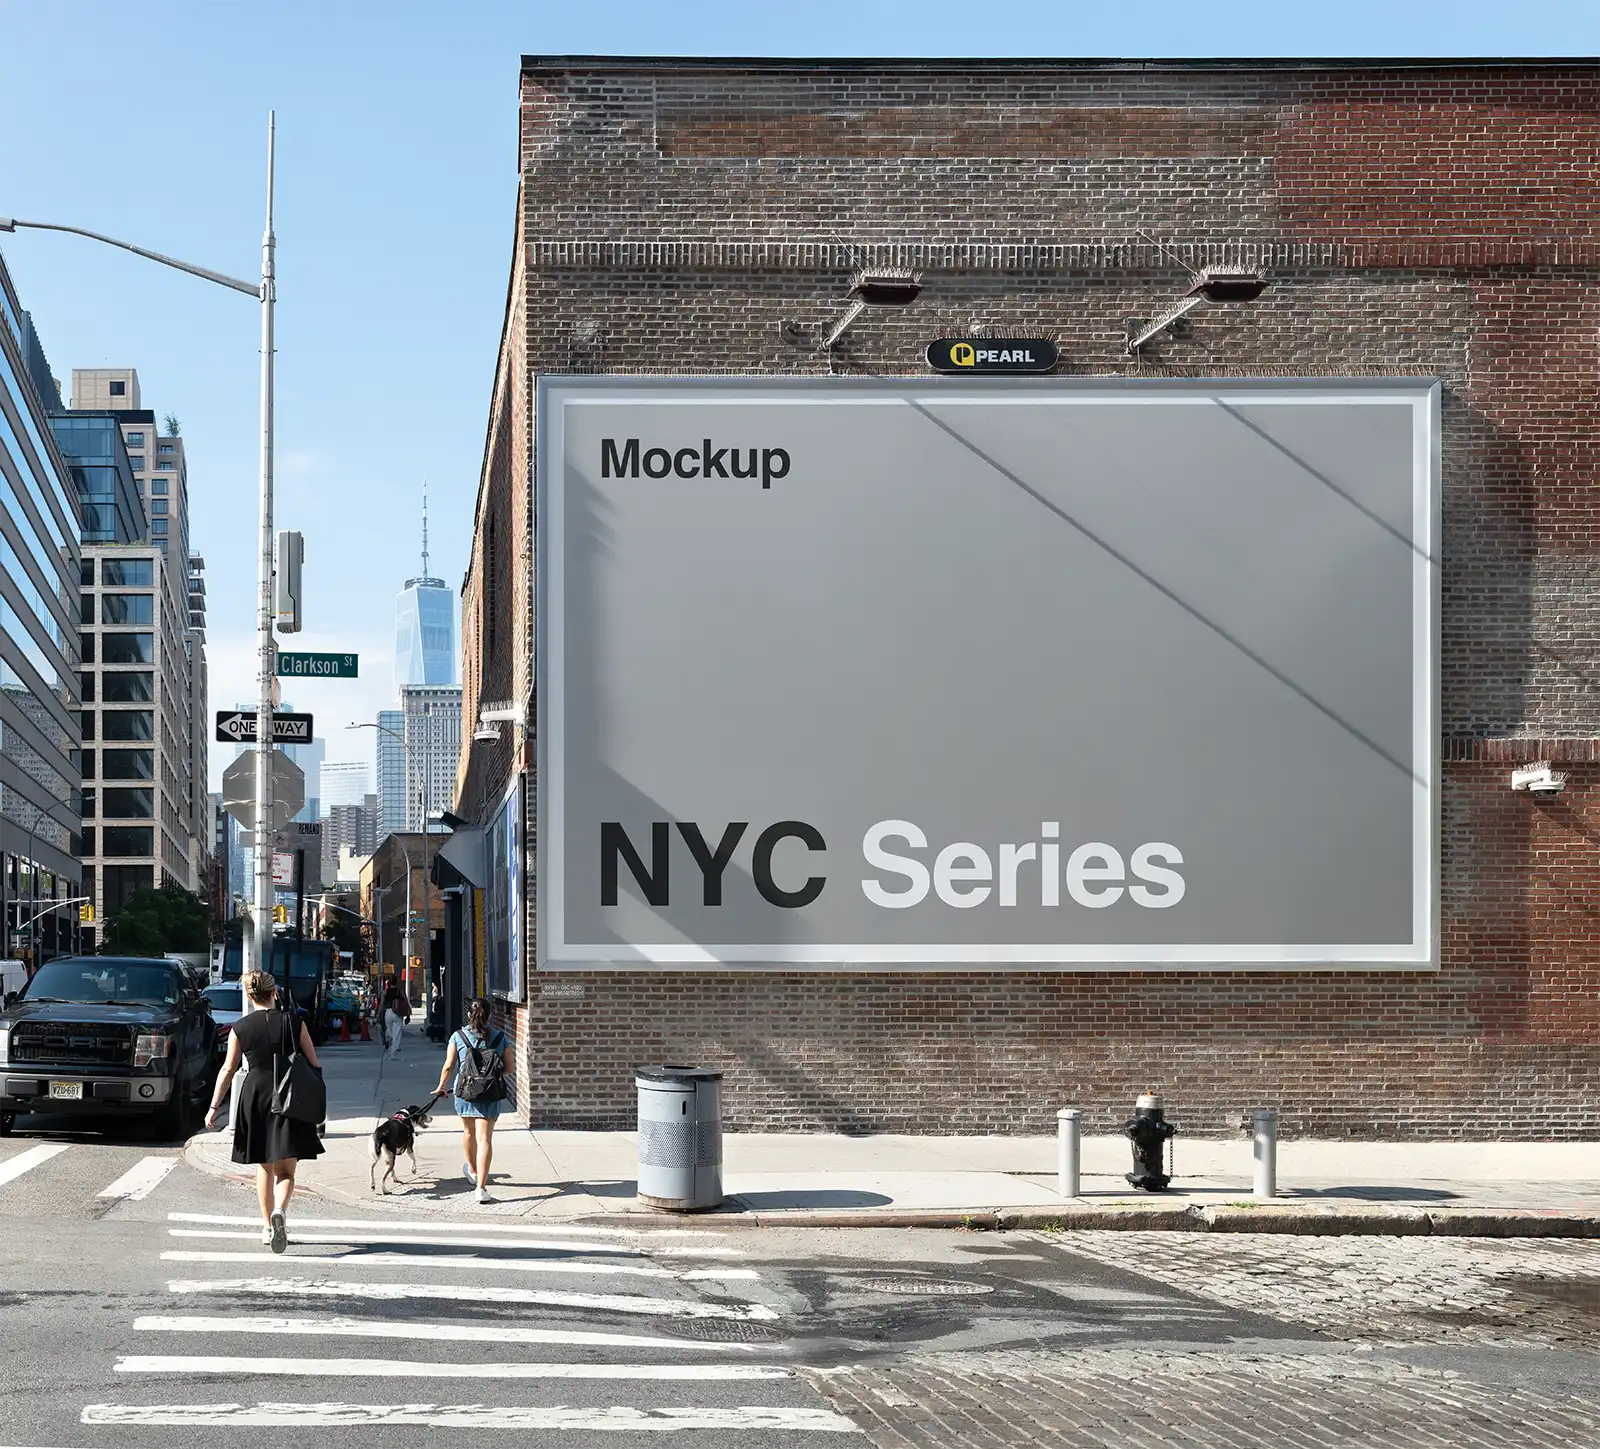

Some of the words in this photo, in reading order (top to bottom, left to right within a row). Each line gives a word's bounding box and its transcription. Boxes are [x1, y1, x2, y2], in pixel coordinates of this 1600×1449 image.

[976, 350, 1035, 362] PEARL
[601, 438, 791, 489] Mockup
[281, 656, 339, 674] Clarkson
[344, 656, 353, 667] St
[229, 721, 257, 733] ONE
[273, 722, 304, 734] WAY
[600, 820, 827, 909] NYC
[861, 819, 1186, 909] Series
